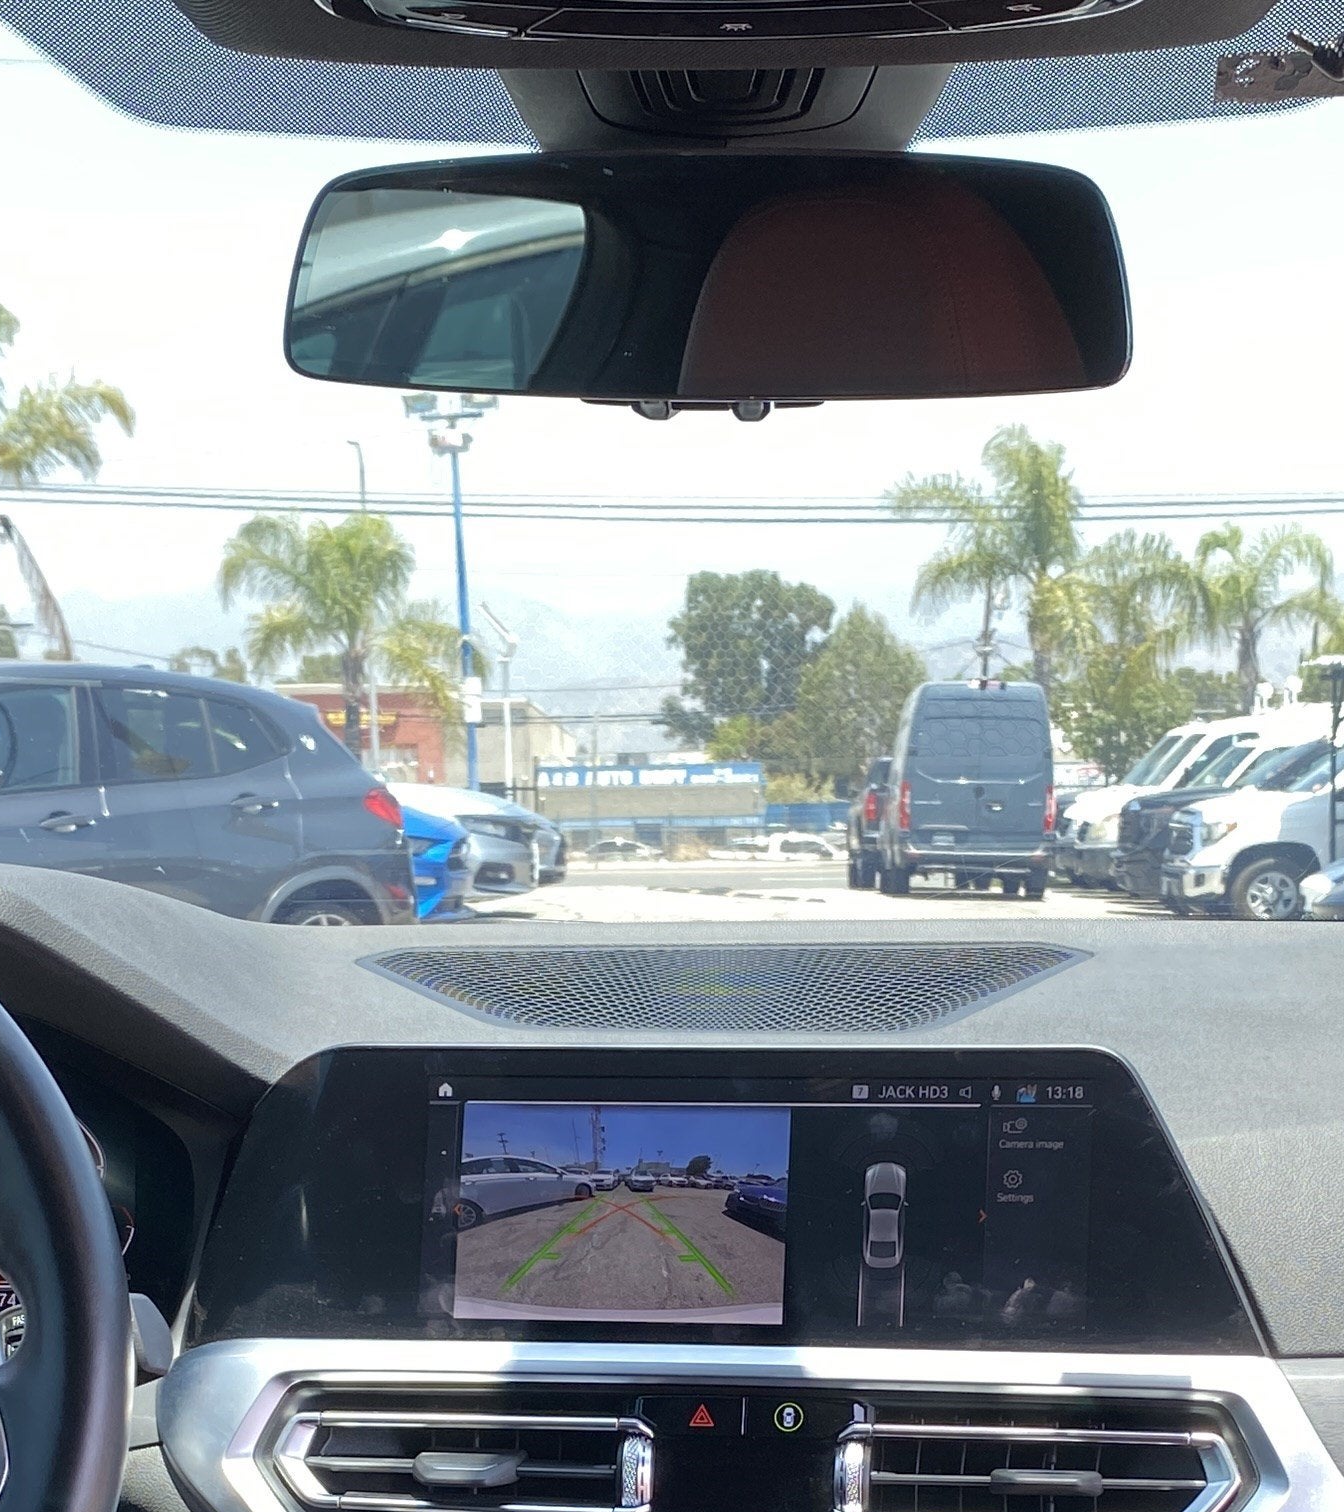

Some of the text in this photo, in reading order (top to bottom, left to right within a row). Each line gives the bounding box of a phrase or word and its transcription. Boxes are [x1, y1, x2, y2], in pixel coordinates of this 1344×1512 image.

[878, 1085, 915, 1099] JACK
[1046, 1086, 1084, 1099] 13:18
[999, 1139, 1064, 1151] Camera image
[997, 1193, 1034, 1203] Settings
[12, 1315, 26, 1326] FAS
